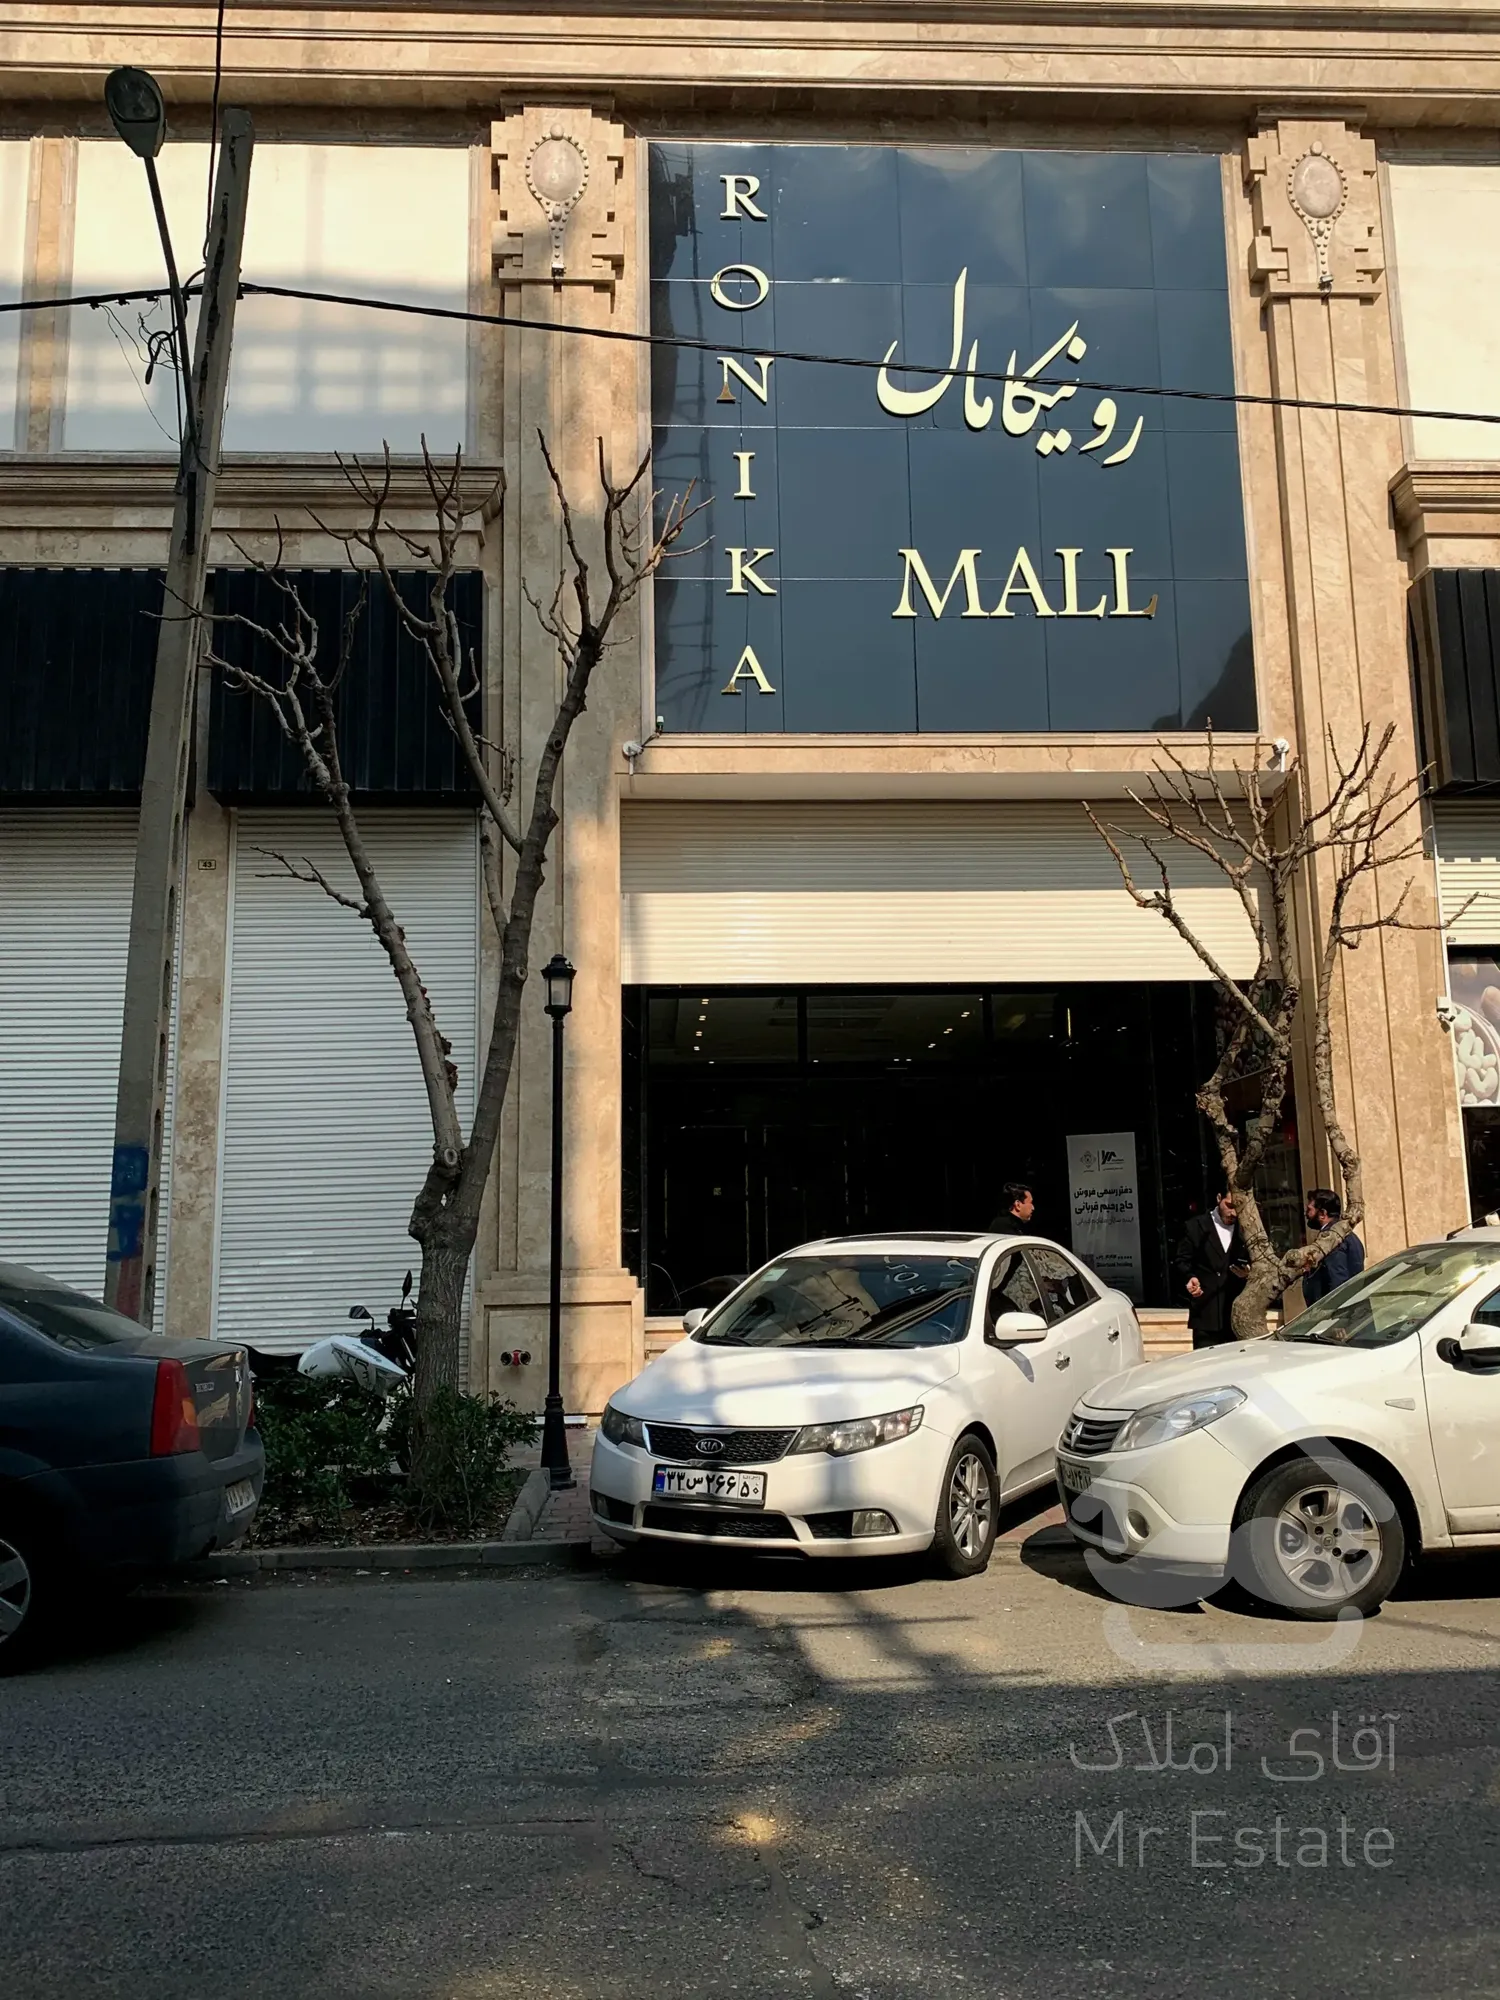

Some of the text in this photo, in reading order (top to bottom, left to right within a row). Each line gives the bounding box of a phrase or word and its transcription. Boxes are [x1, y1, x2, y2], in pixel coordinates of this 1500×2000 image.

[877, 267, 994, 432] مال
[710, 173, 777, 695] RONIKA
[891, 546, 1158, 620] MALL
[1074, 1187, 1096, 1199] فروش
[1097, 1188, 1118, 1198] رسمی
[1075, 1200, 1133, 1215] حاج رحیم قربانی
[701, 1441, 720, 1451] KIA
